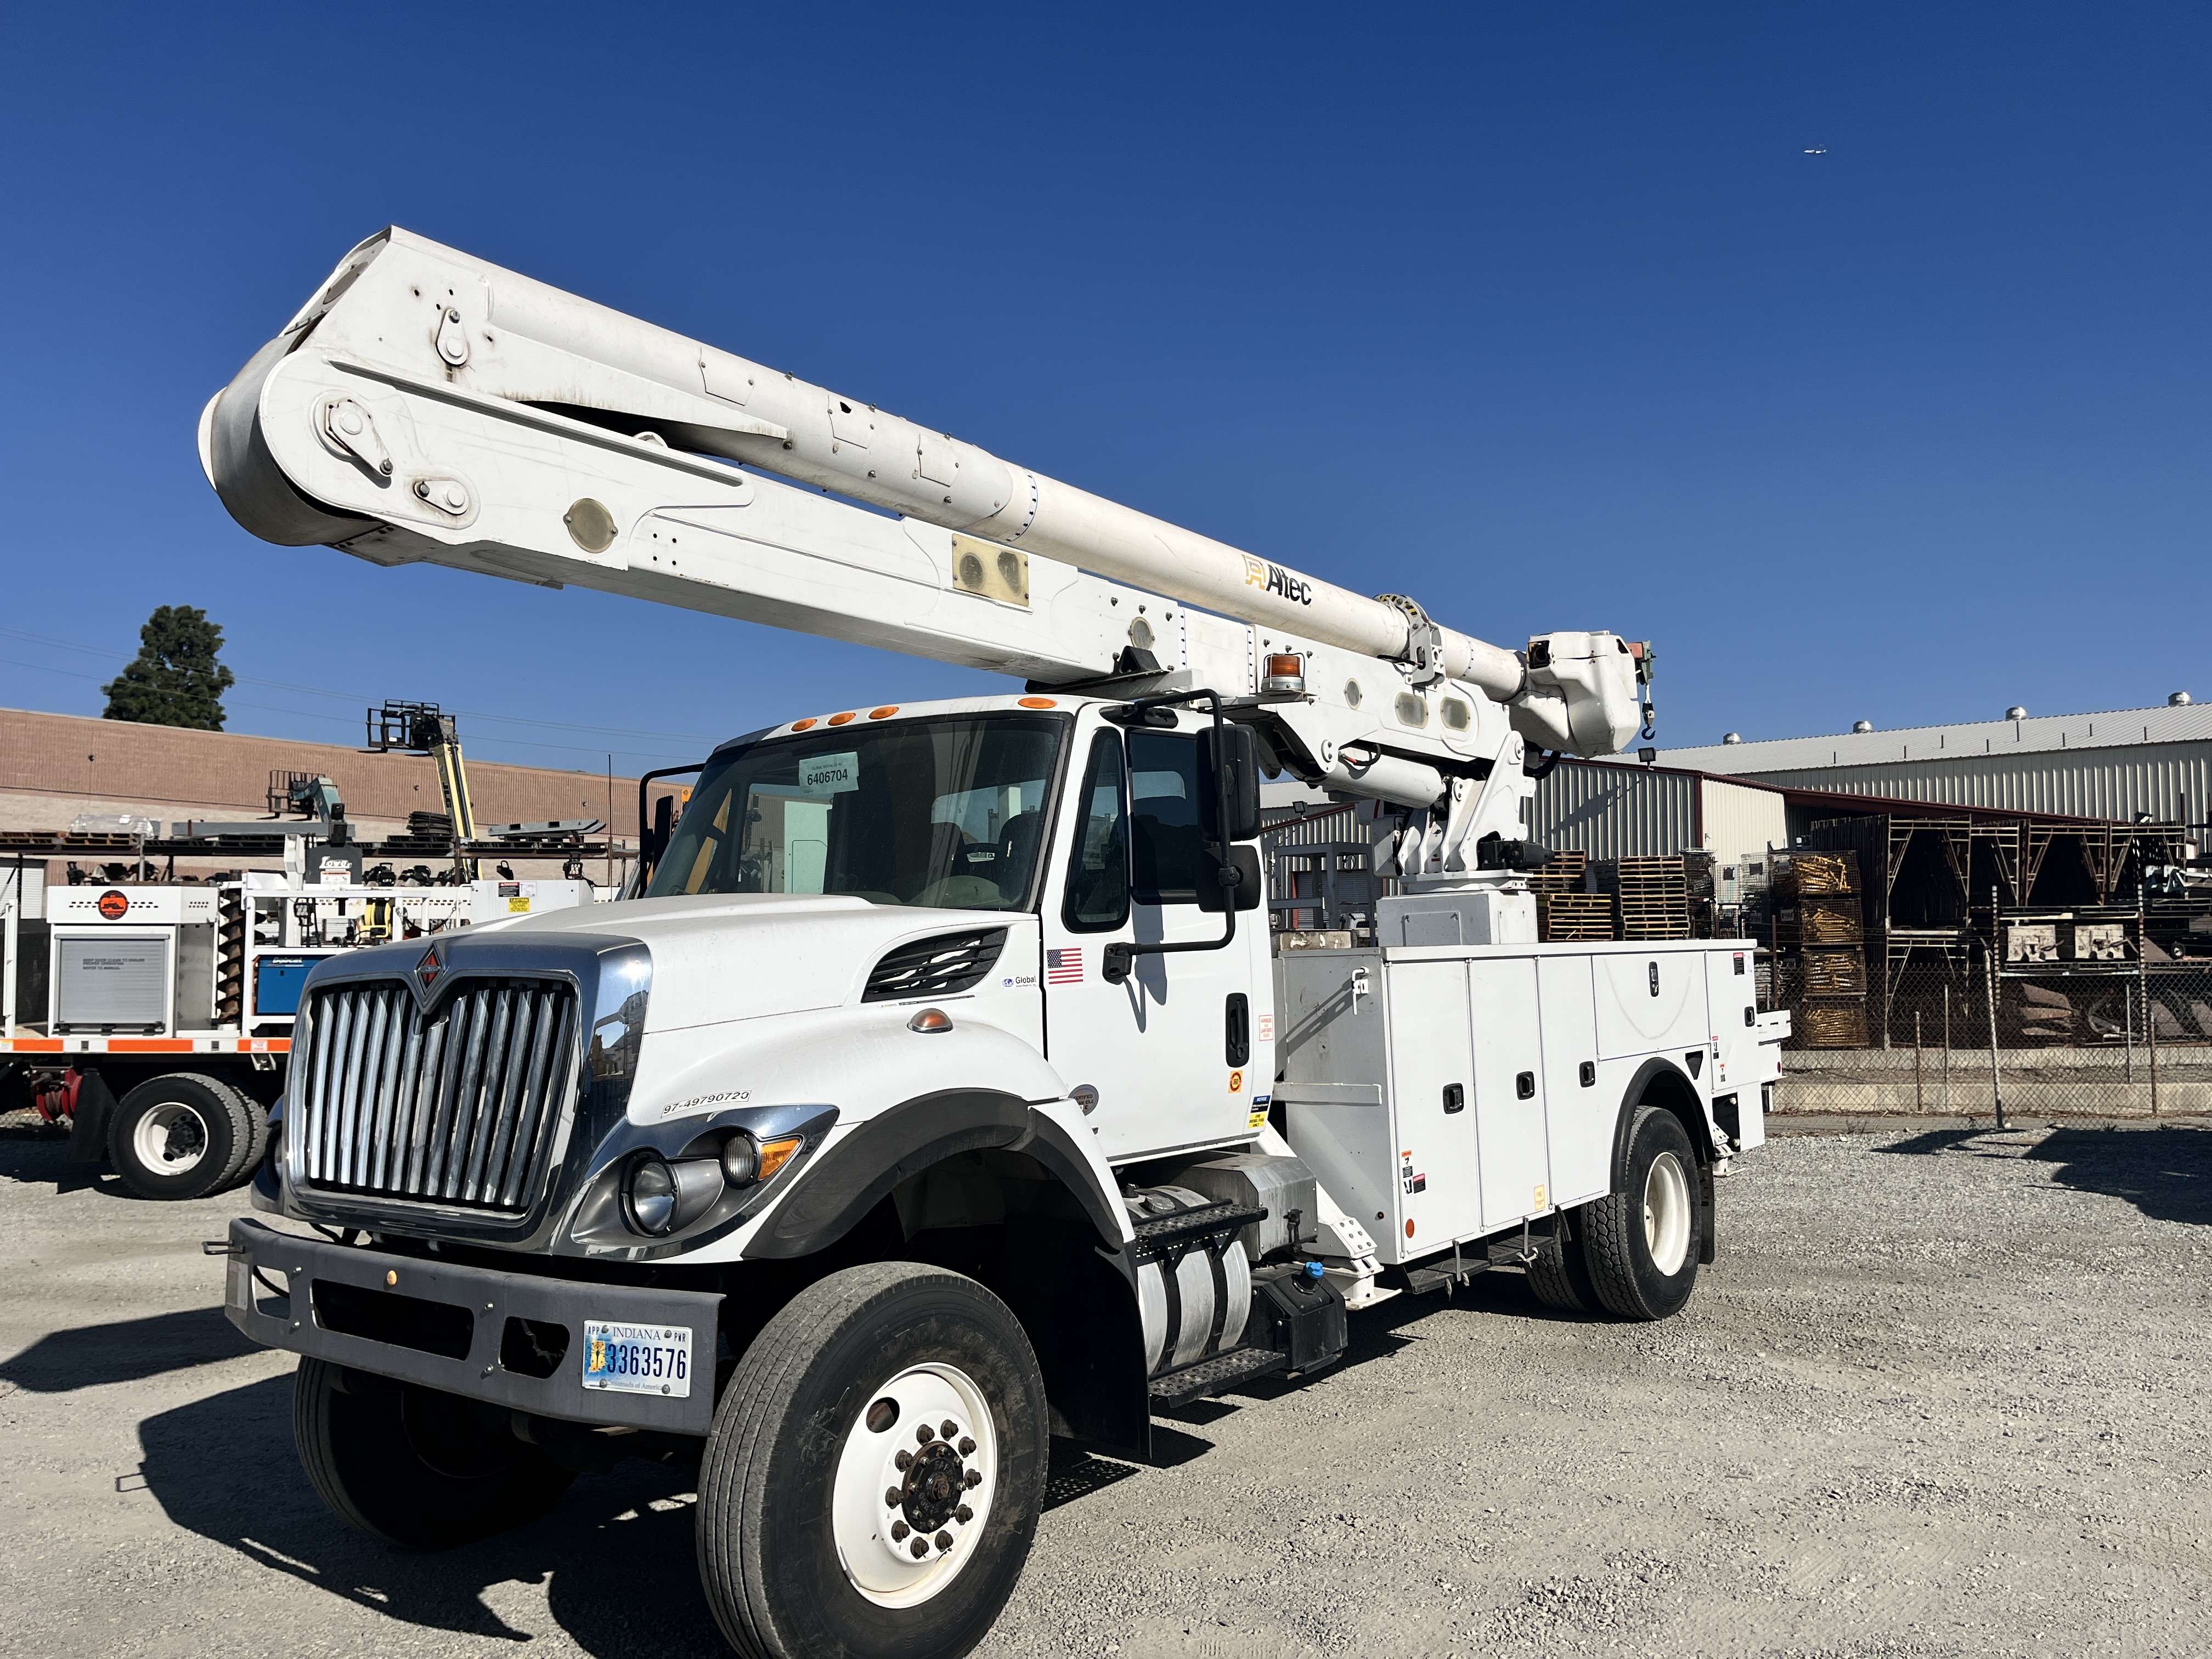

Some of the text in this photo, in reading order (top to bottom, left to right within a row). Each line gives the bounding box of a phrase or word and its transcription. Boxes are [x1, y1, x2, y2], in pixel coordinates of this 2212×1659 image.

[1266, 563, 1312, 606] Altec
[807, 769, 848, 786] 6406704
[1015, 975, 1036, 984] Global
[663, 1091, 749, 1114] 97-49790720
[588, 1326, 686, 1342] APP INDIANA PWR
[607, 1344, 686, 1379] 3363576
